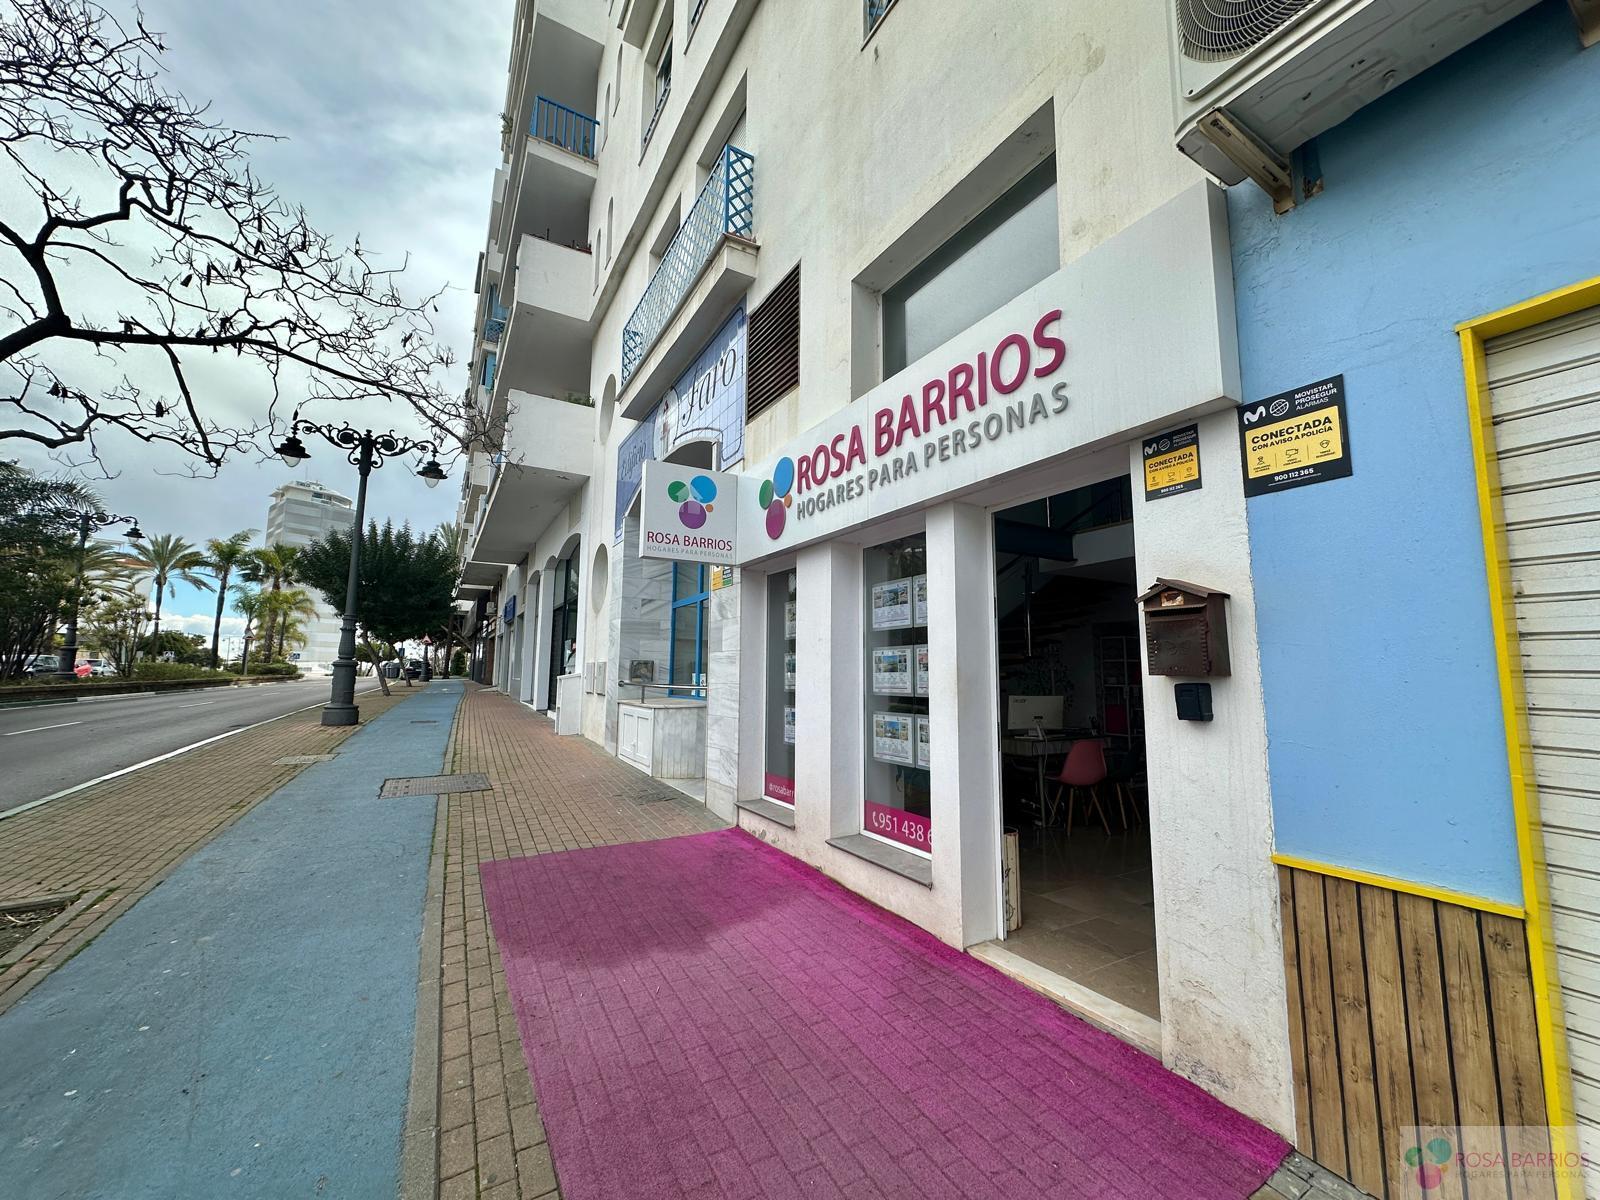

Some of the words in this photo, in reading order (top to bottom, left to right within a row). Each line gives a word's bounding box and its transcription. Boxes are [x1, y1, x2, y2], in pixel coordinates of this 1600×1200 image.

[682, 348, 737, 428] Faro
[1294, 382, 1334, 400] MOVISTAR
[1295, 387, 1338, 405] PROSEGUR
[797, 425, 866, 495] ROSA
[874, 309, 1067, 457] BARRIOS
[1295, 397, 1329, 411] ALARMAS
[1251, 416, 1332, 445] CONECTADA
[1252, 442, 1269, 452] CON
[1269, 436, 1293, 448] AVISO
[1301, 425, 1333, 439] POLICÍA
[796, 474, 865, 521] HOGARES
[868, 452, 919, 491] PARA
[924, 381, 1069, 468] PERSONAS
[1148, 452, 1194, 469] CONECTADA
[1274, 473, 1288, 482] 900
[1288, 471, 1299, 479] 112
[1299, 467, 1314, 477] 365
[647, 531, 680, 546] ROSA
[683, 535, 733, 551] BARRIOS
[647, 545, 679, 554] HOGARES
[680, 548, 698, 556] PARA
[699, 550, 733, 559] PERSONAS
[879, 812, 898, 834] 951
[902, 820, 924, 842] 438
